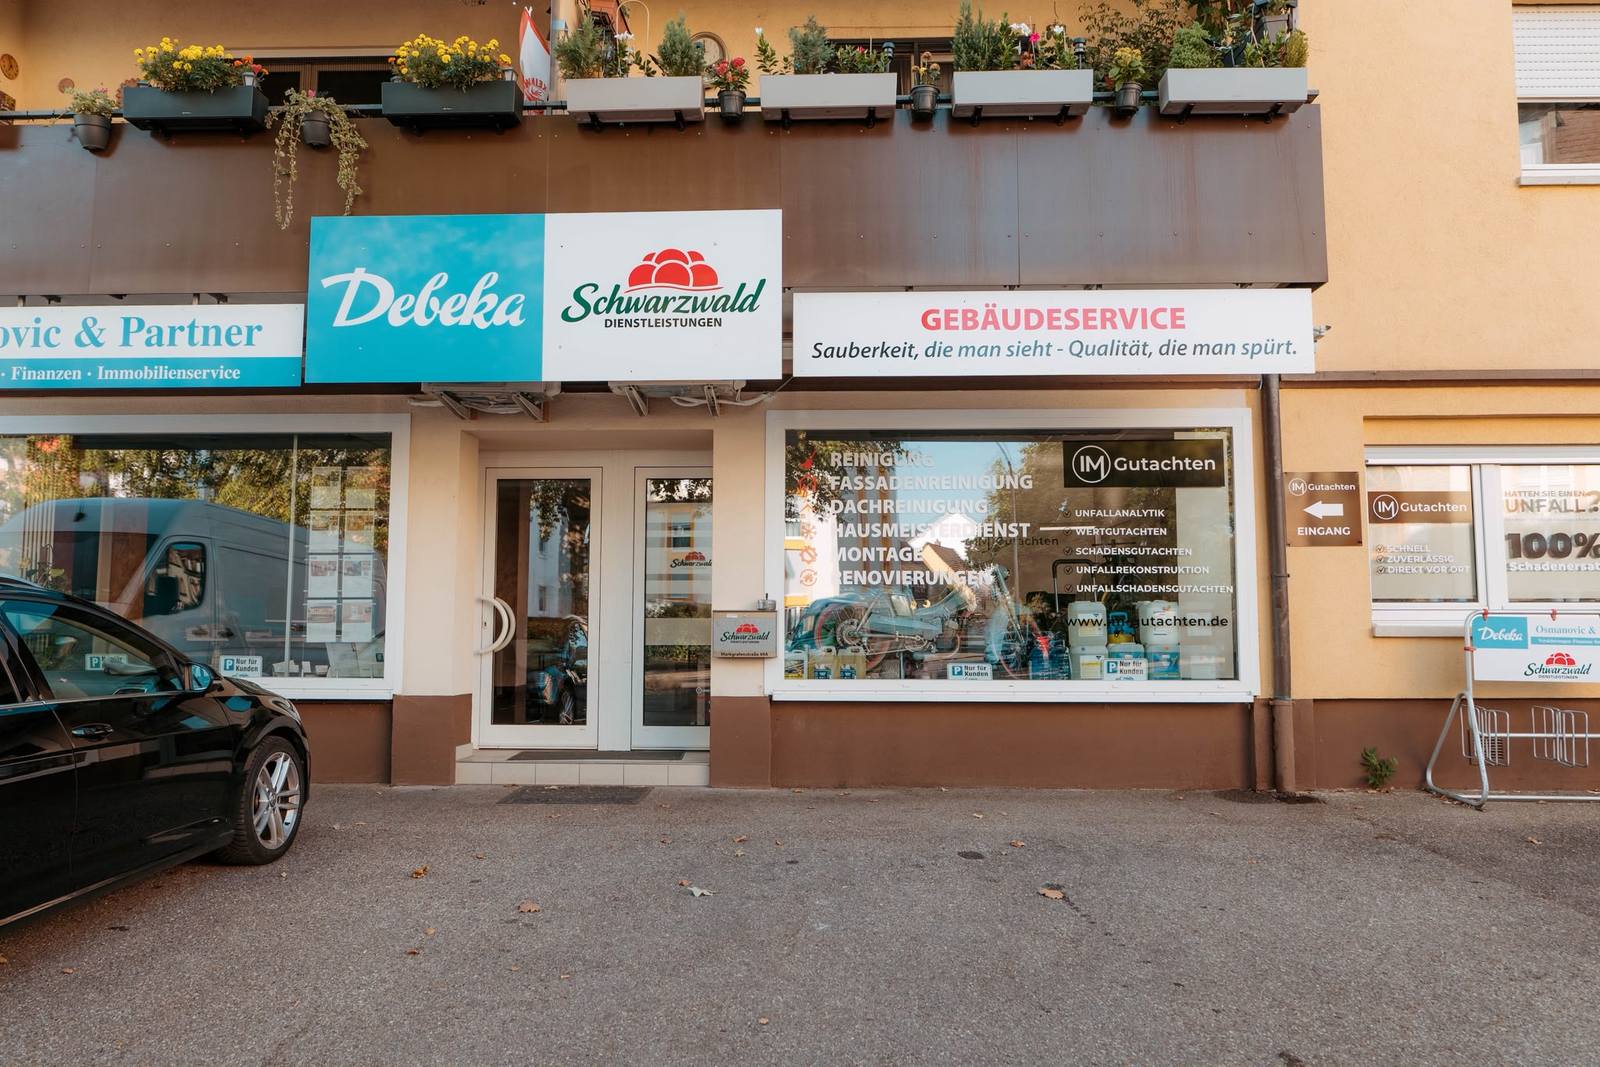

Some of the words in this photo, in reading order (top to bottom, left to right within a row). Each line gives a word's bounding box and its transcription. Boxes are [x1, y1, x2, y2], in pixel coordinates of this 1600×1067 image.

[321, 266, 527, 330] Debeka
[561, 278, 767, 323] Schwarzwald
[604, 317, 723, 328] DIENSTLEISTUNGEN
[920, 302, 1187, 332] GEBÄUDESERVICE
[74, 315, 107, 348] &
[119, 315, 264, 348] Partner
[811, 341, 919, 360] Sauberkeit,
[924, 340, 953, 358] die
[958, 343, 1001, 358] man
[1005, 339, 1053, 358] sieht
[1068, 339, 1153, 359] Qualität,
[1158, 339, 1188, 356] die
[1192, 342, 1236, 356] man
[1240, 338, 1298, 360] spürt.
[10, 366, 82, 381] Finanzen
[96, 365, 241, 380] Immobilienservice
[829, 452, 936, 468] REINIGUNG
[1079, 455, 1106, 481] IM
[1113, 456, 1217, 472] Gutachten
[830, 474, 1034, 491] FASSADENREINIGUNG
[1308, 483, 1356, 492] Gutachten
[829, 498, 989, 515] DACHREINIGUNG
[1075, 509, 1166, 518] UNFALLANALYTIK
[1377, 500, 1396, 518] IM
[1400, 502, 1468, 512] Gutachten
[1075, 527, 1168, 536] WERTGUTACHTEN
[1296, 527, 1351, 536] EINGANG
[834, 546, 925, 562] MONTAGE
[1075, 547, 1193, 556] SCHADENSGUTACHTEN
[1387, 544, 1431, 553] SCHNELL
[1076, 566, 1210, 575] UNFALLREKONSTRUKTION
[1387, 565, 1423, 574] DIREKT
[1427, 565, 1448, 574] VOR
[1450, 565, 1471, 574] ORT
[1076, 584, 1234, 593] UNFALLSCHADENSGUTACHTEN
[720, 631, 771, 642] Schwarzwald
[1477, 626, 1523, 641] Debeka
[1524, 662, 1592, 677] Schwarzwald
